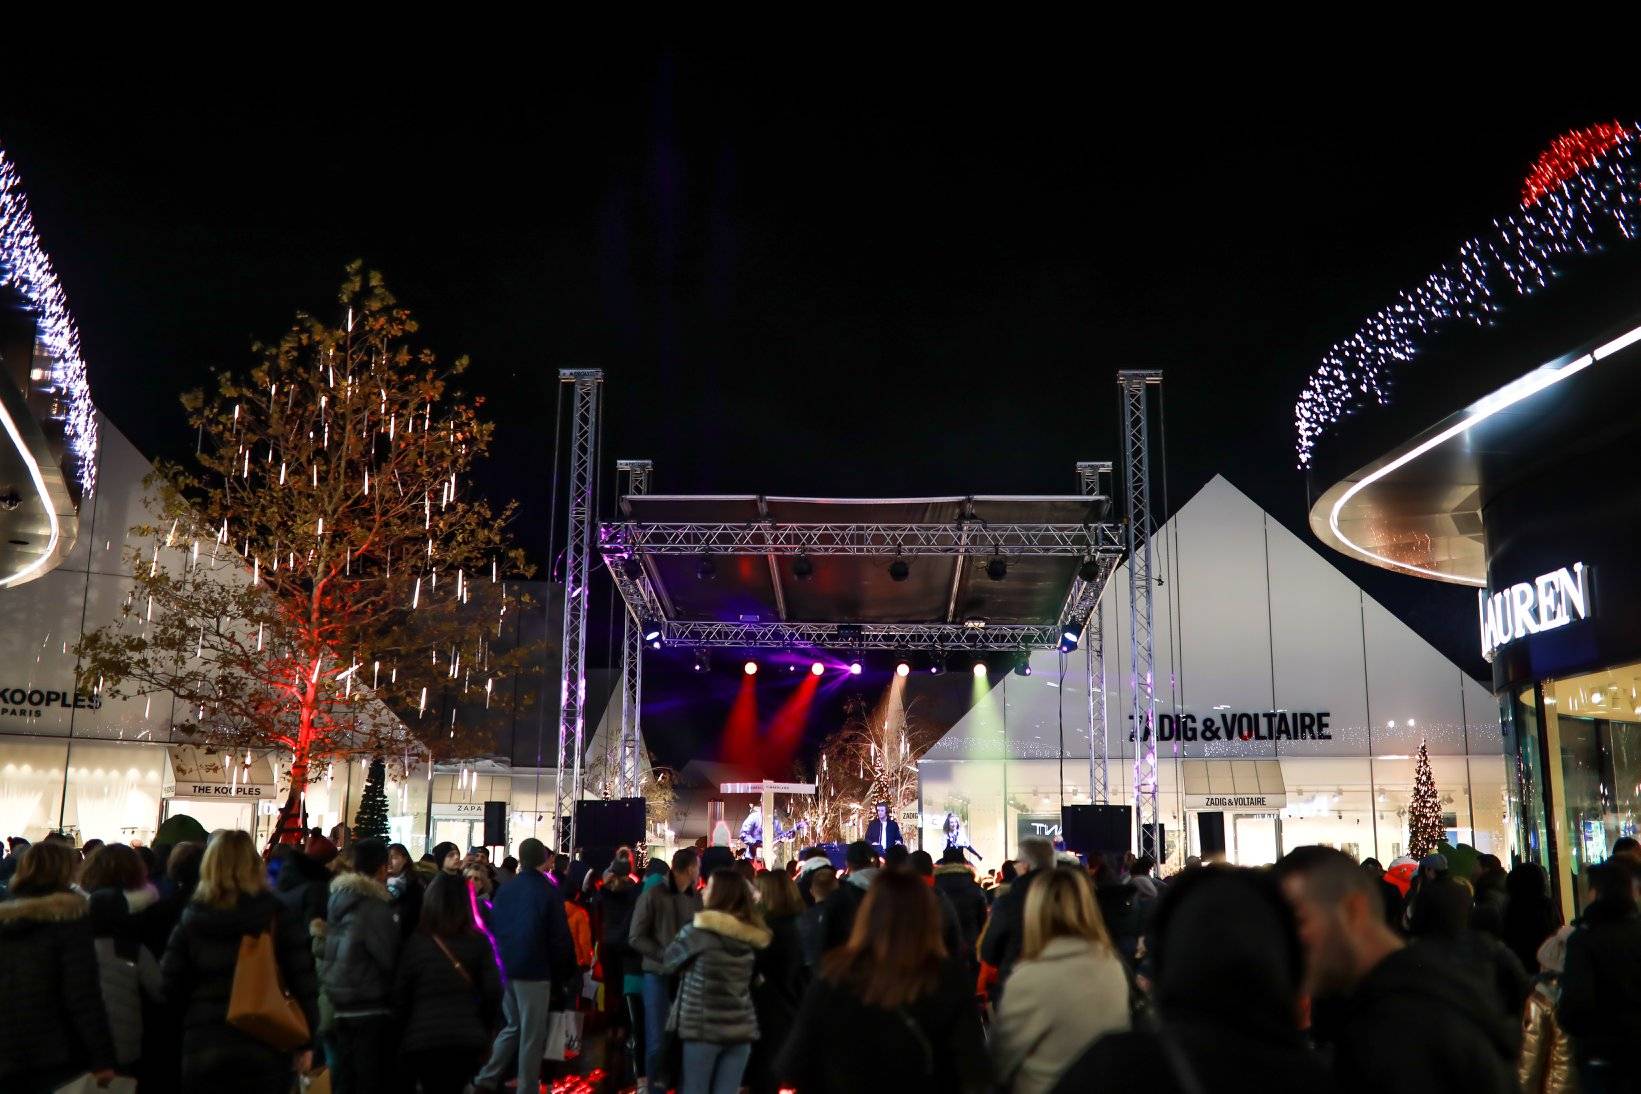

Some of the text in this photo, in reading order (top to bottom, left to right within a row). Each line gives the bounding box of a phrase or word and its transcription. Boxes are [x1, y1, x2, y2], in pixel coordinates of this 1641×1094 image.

[1478, 561, 1586, 662] LAUREN
[1, 708, 41, 717] PARIS
[192, 785, 211, 794] THE
